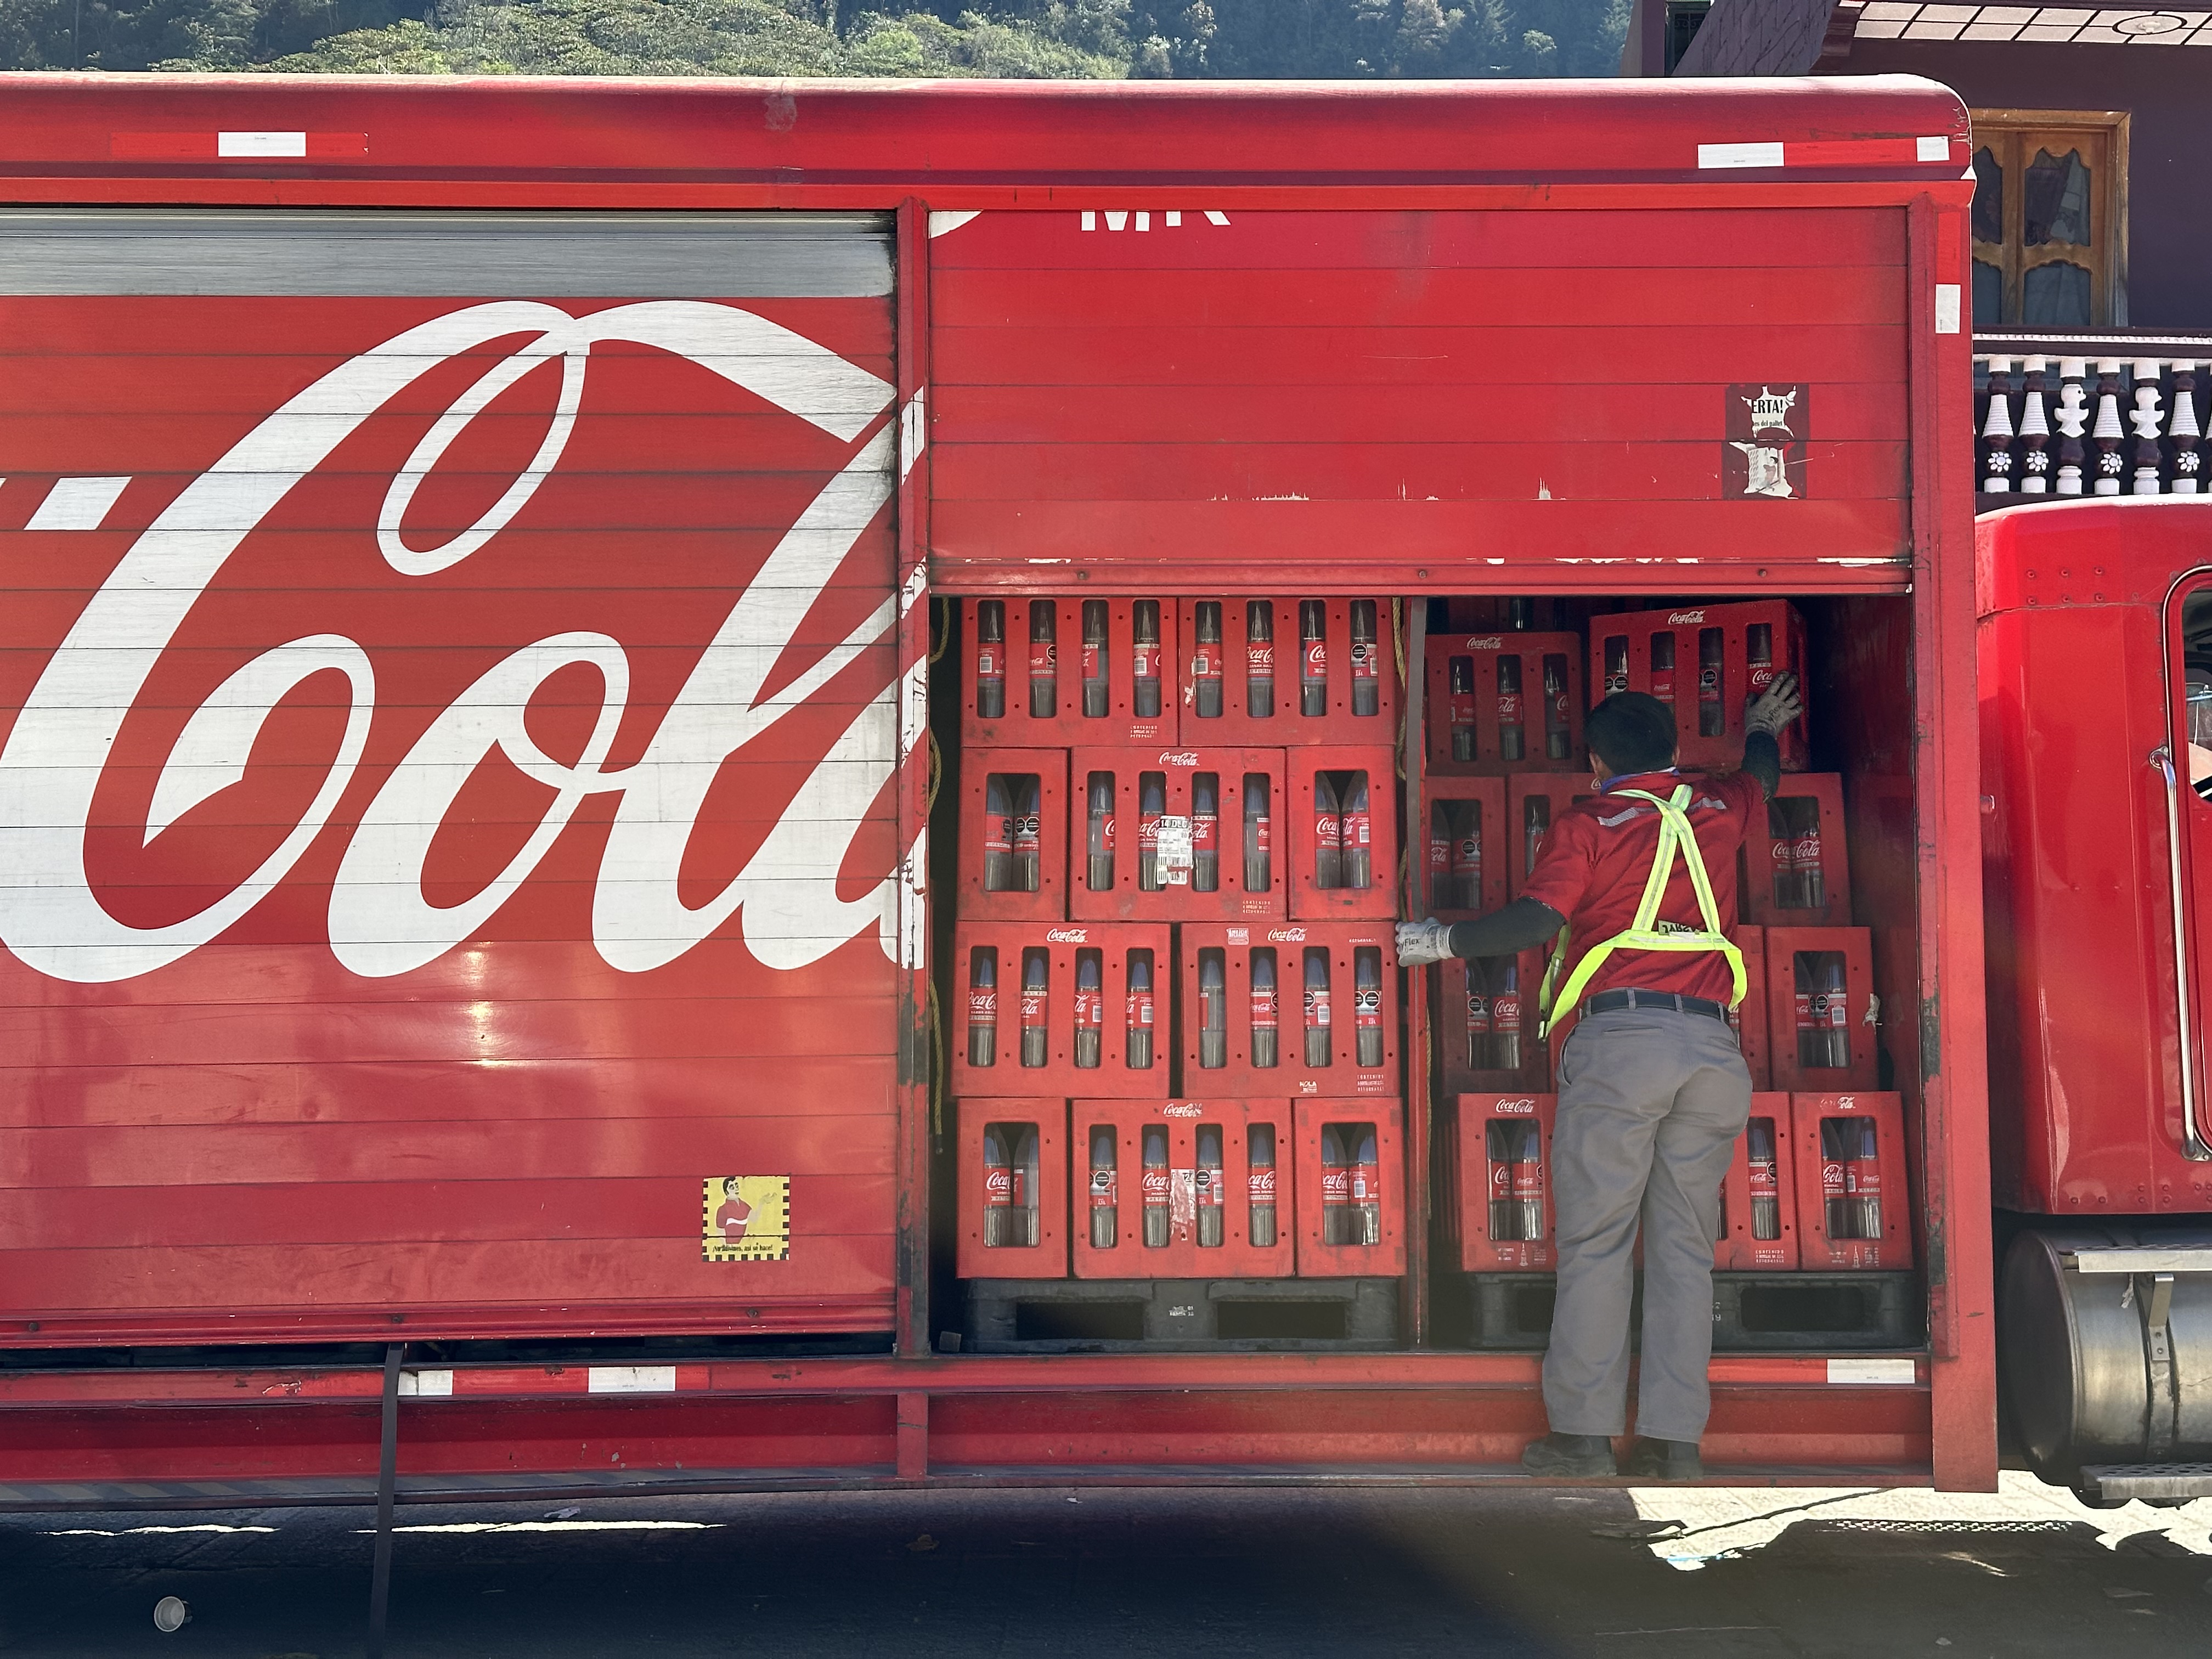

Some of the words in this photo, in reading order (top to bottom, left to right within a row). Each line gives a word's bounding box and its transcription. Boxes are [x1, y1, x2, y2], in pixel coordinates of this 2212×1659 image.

[1159, 752, 1200, 766] Coca-Cola
[1047, 928, 1088, 943] Coca-Cola
[1268, 927, 1308, 942] Coca-Cola
[1496, 1098, 1535, 1113] Coca-Cola
